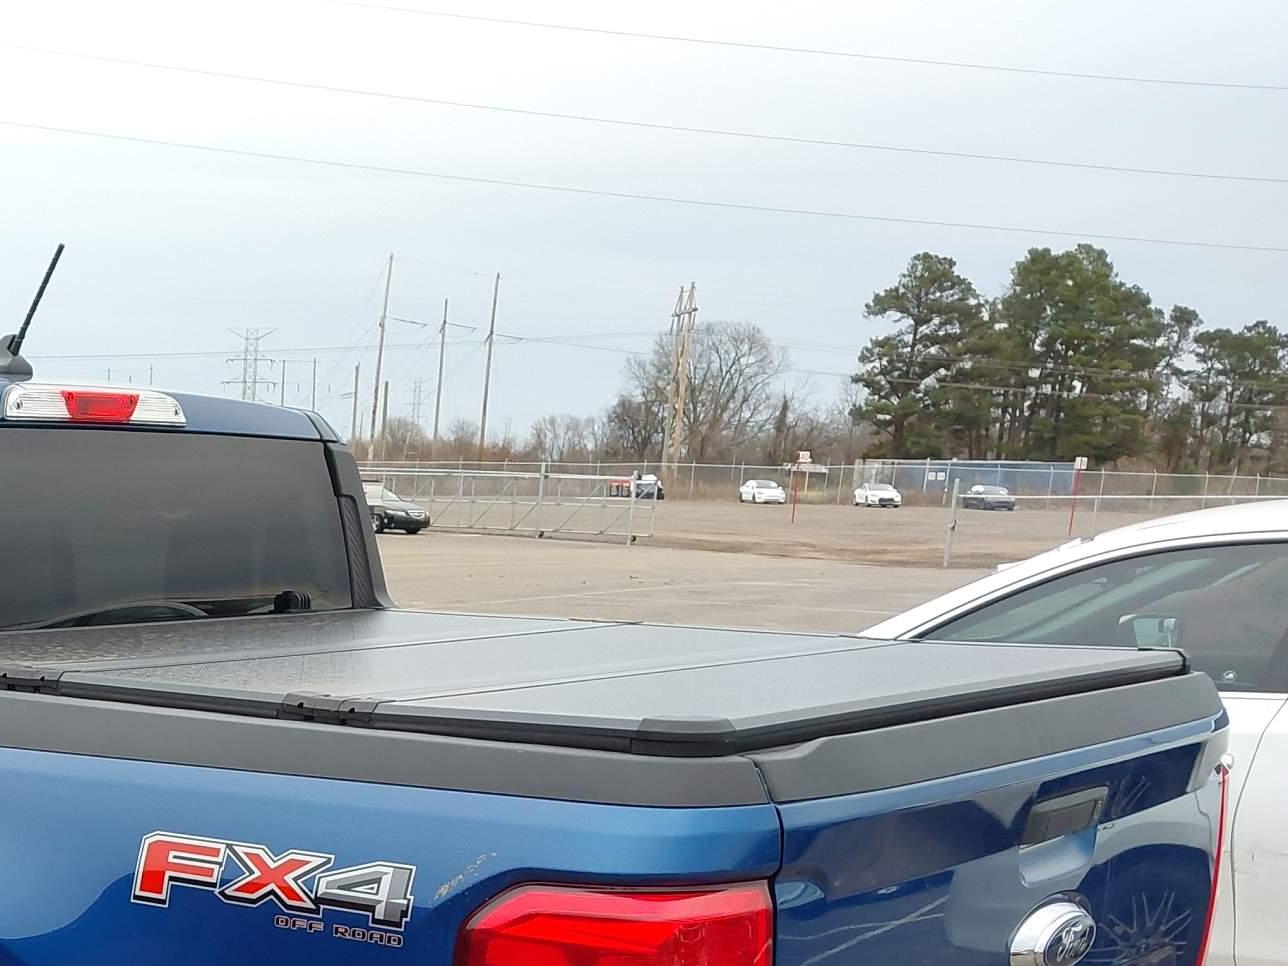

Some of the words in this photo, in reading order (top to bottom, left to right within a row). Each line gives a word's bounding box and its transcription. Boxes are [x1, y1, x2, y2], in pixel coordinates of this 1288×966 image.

[131, 831, 417, 931] FX4
[274, 915, 324, 933] OFF
[333, 924, 404, 948] ROAD
[1054, 918, 1091, 963] Ford
